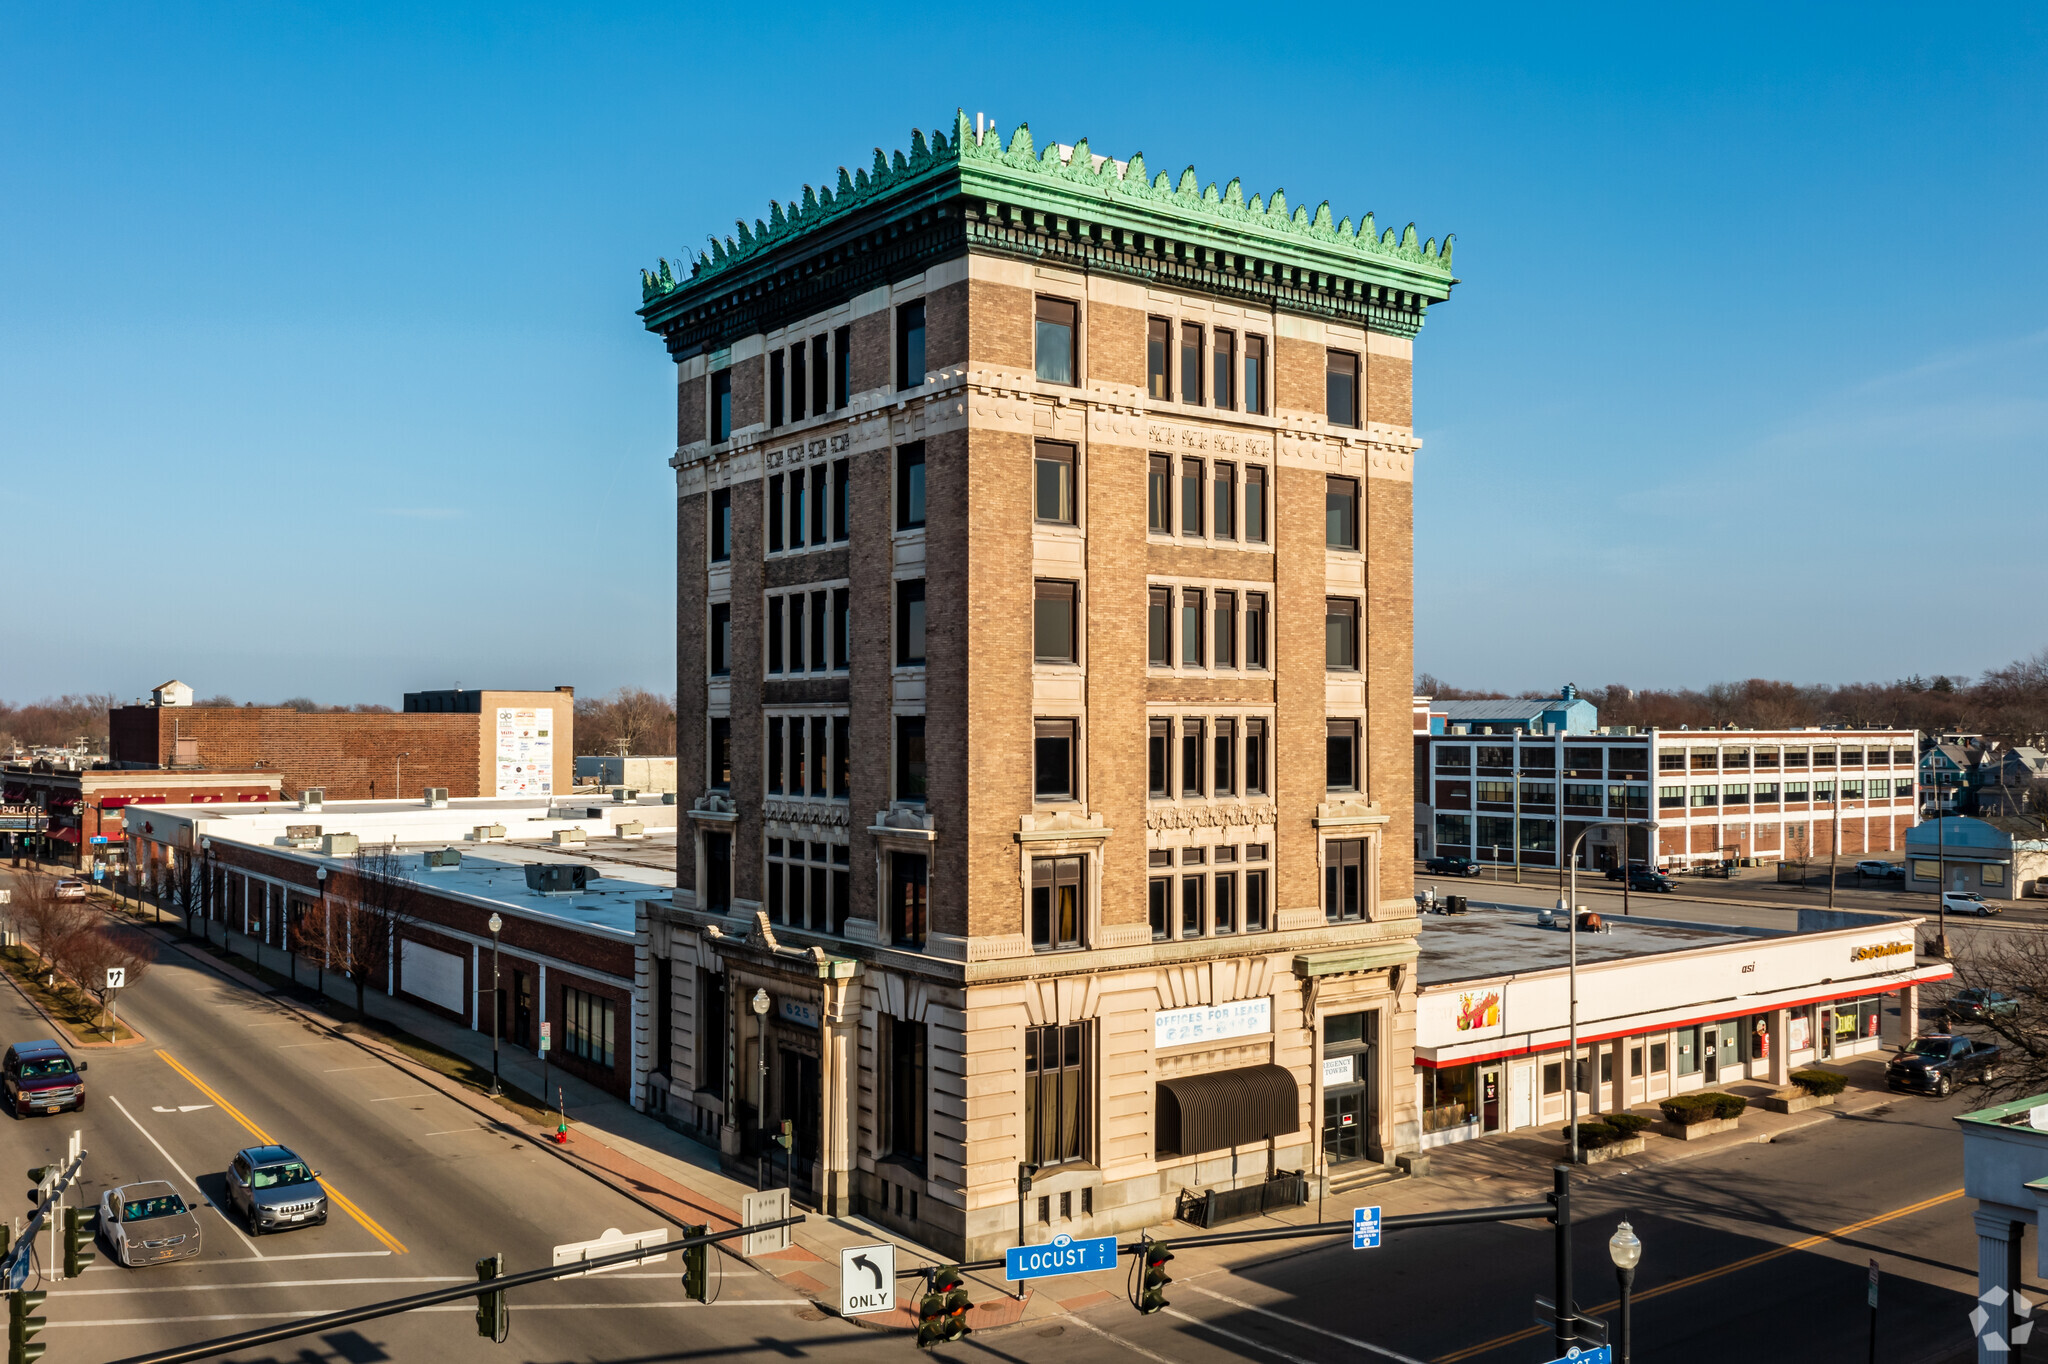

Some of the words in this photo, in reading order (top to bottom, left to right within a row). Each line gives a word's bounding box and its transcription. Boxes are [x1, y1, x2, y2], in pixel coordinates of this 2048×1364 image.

[1858, 947, 1875, 960] Sub
[1741, 961, 1756, 973] asi
[1156, 1012, 1202, 1027] OFFICES
[1208, 1009, 1229, 1021] FOR
[1235, 1003, 1267, 1017] LEASE
[1325, 1066, 1348, 1076] TOWER
[1019, 1248, 1086, 1271] LOCUST
[849, 1292, 888, 1309] ONLY
